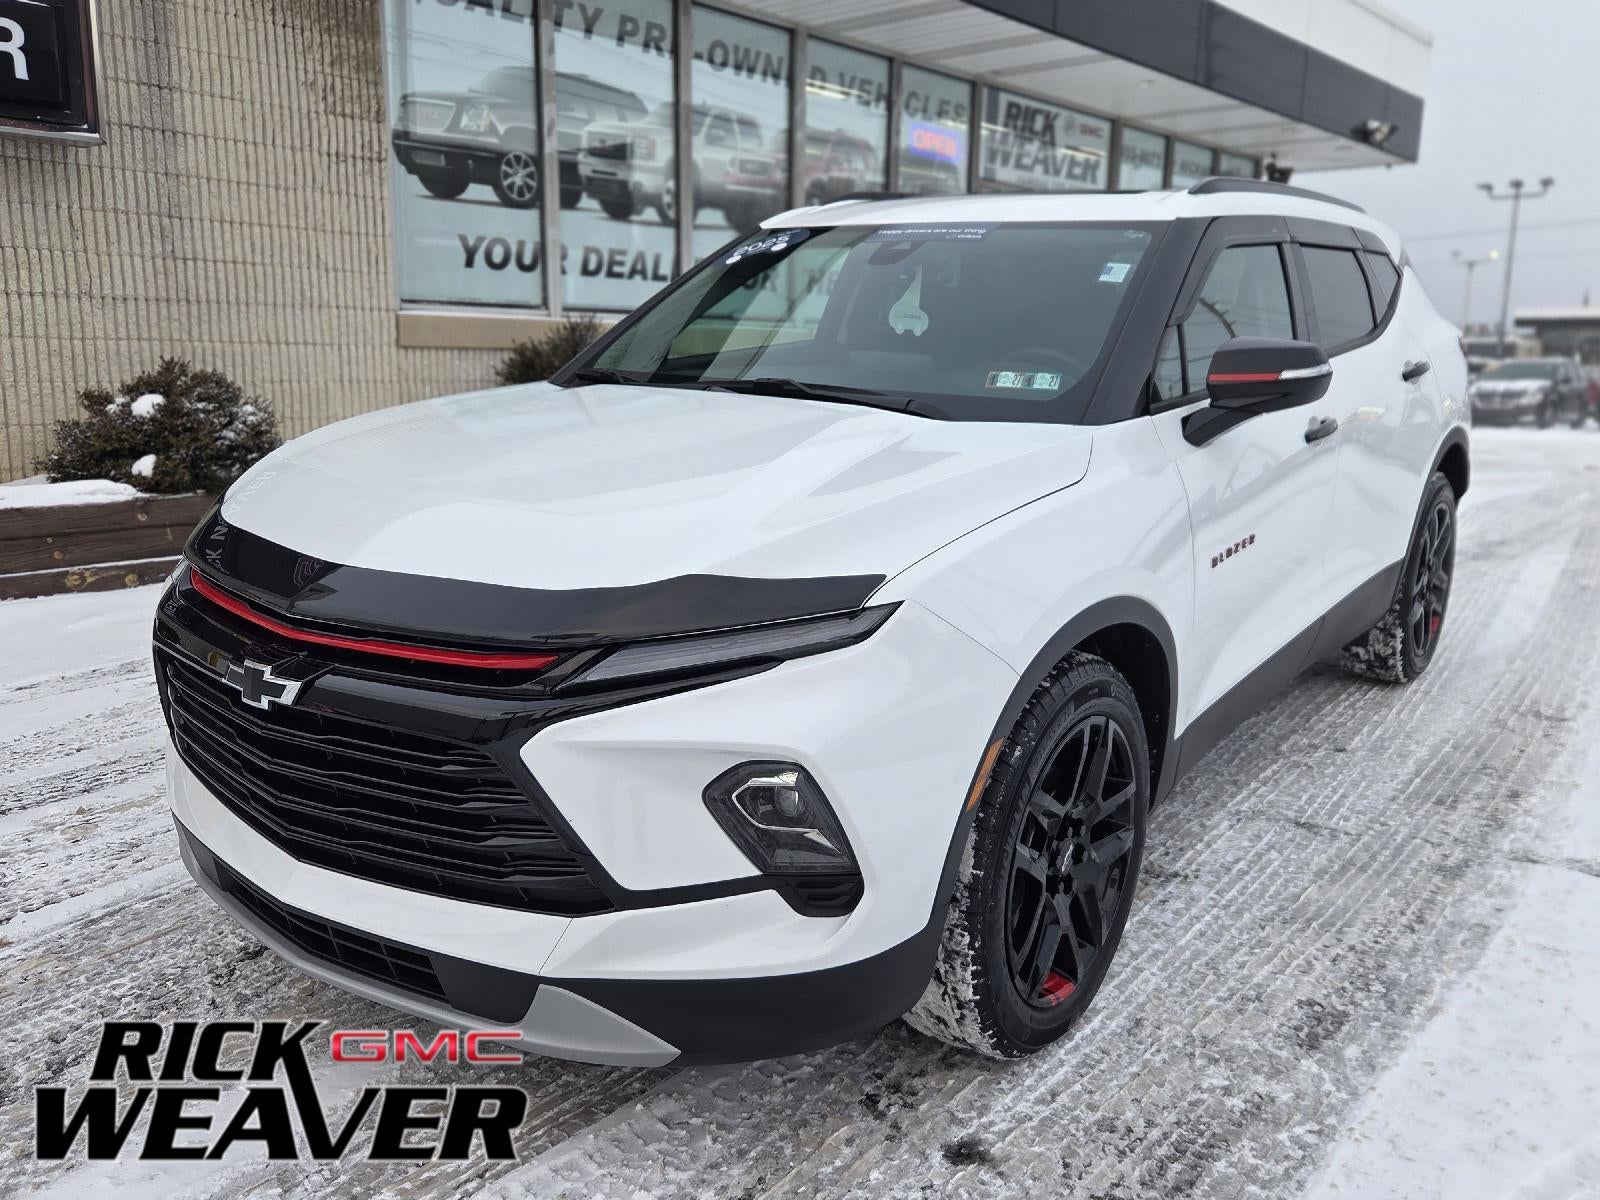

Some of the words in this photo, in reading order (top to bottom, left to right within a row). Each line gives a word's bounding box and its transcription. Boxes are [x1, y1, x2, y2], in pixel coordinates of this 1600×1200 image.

[616, 13, 827, 90] PR-OWND
[839, 71, 968, 122] VEHCLES
[1003, 100, 1061, 143] RICK
[911, 128, 958, 157] OPEN
[988, 135, 1101, 184] WEAVER
[733, 234, 790, 256] 2025
[1211, 533, 1256, 568] BLAZER
